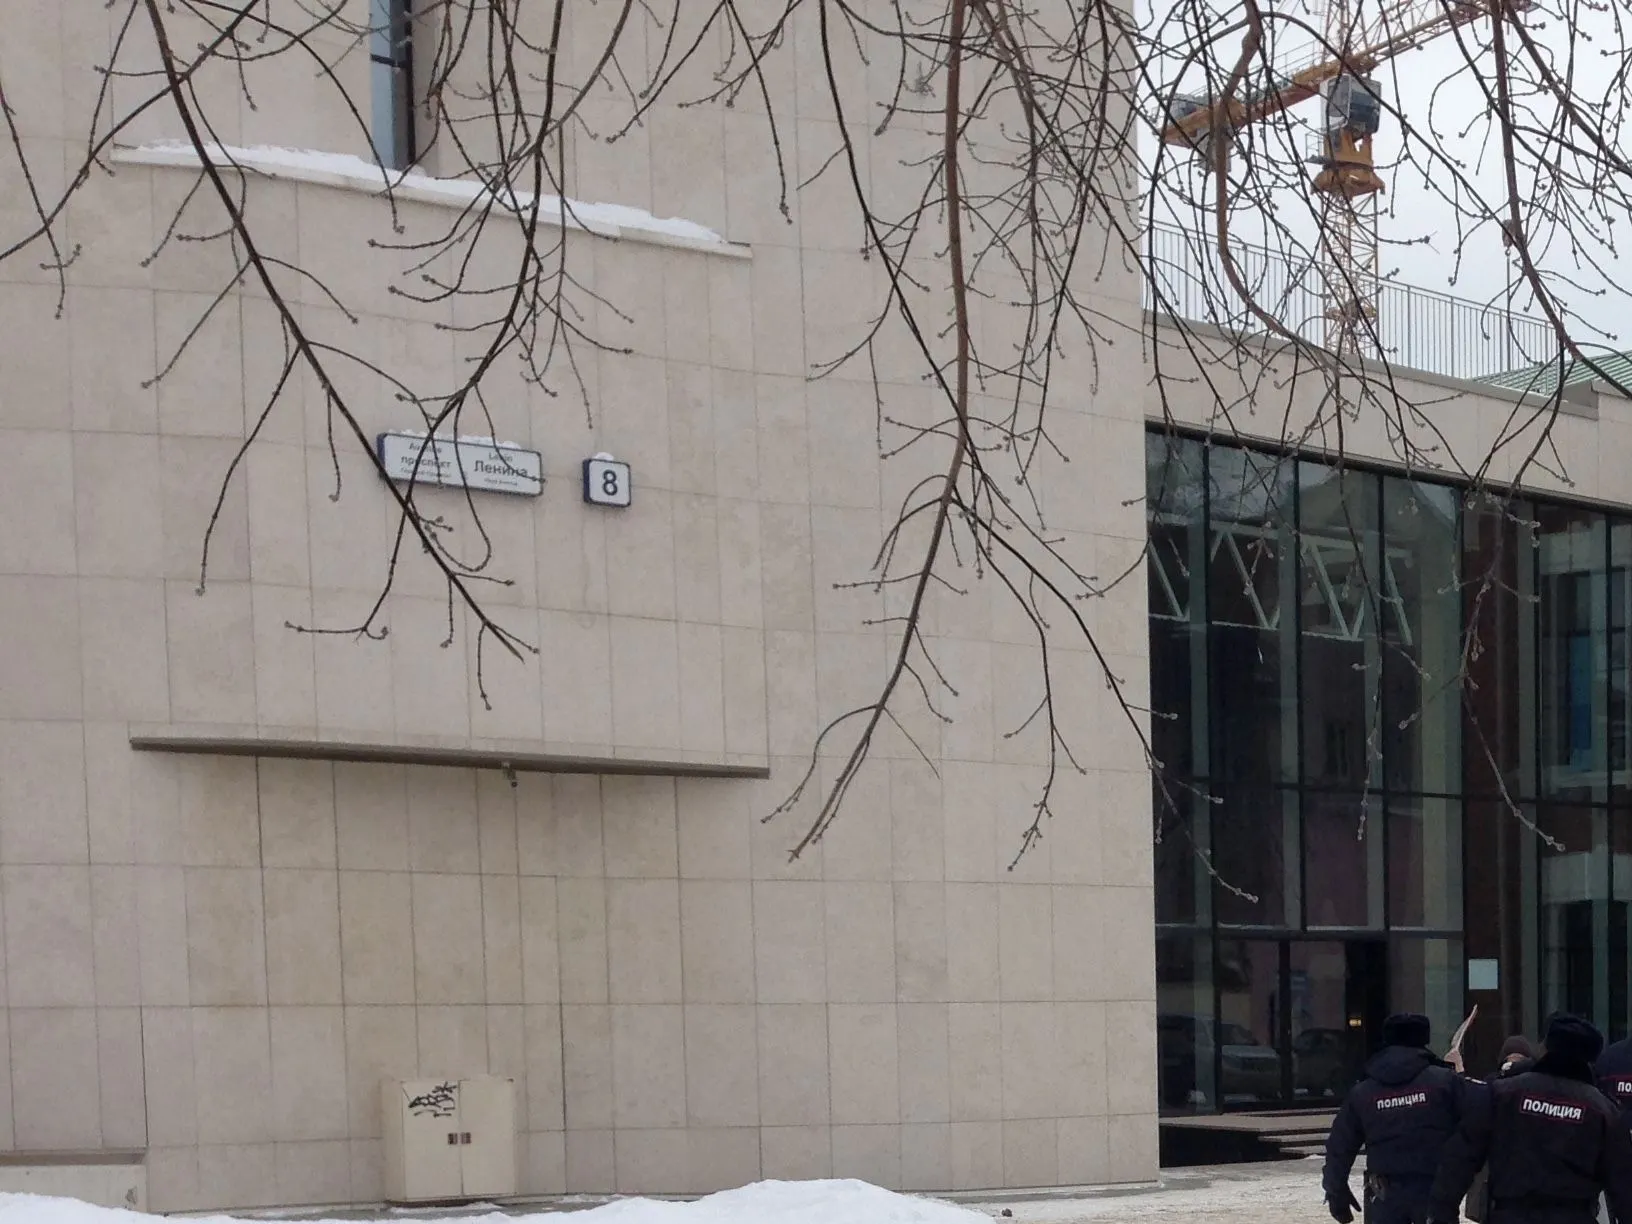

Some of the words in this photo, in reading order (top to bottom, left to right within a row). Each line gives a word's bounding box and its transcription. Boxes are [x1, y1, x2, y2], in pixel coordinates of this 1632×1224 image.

[400, 456, 452, 468] прспект
[601, 469, 618, 496] 8
[1376, 1091, 1427, 1111] ПОЛИЦИЯ
[1522, 1097, 1582, 1121] ПОЛИЦИЯ
